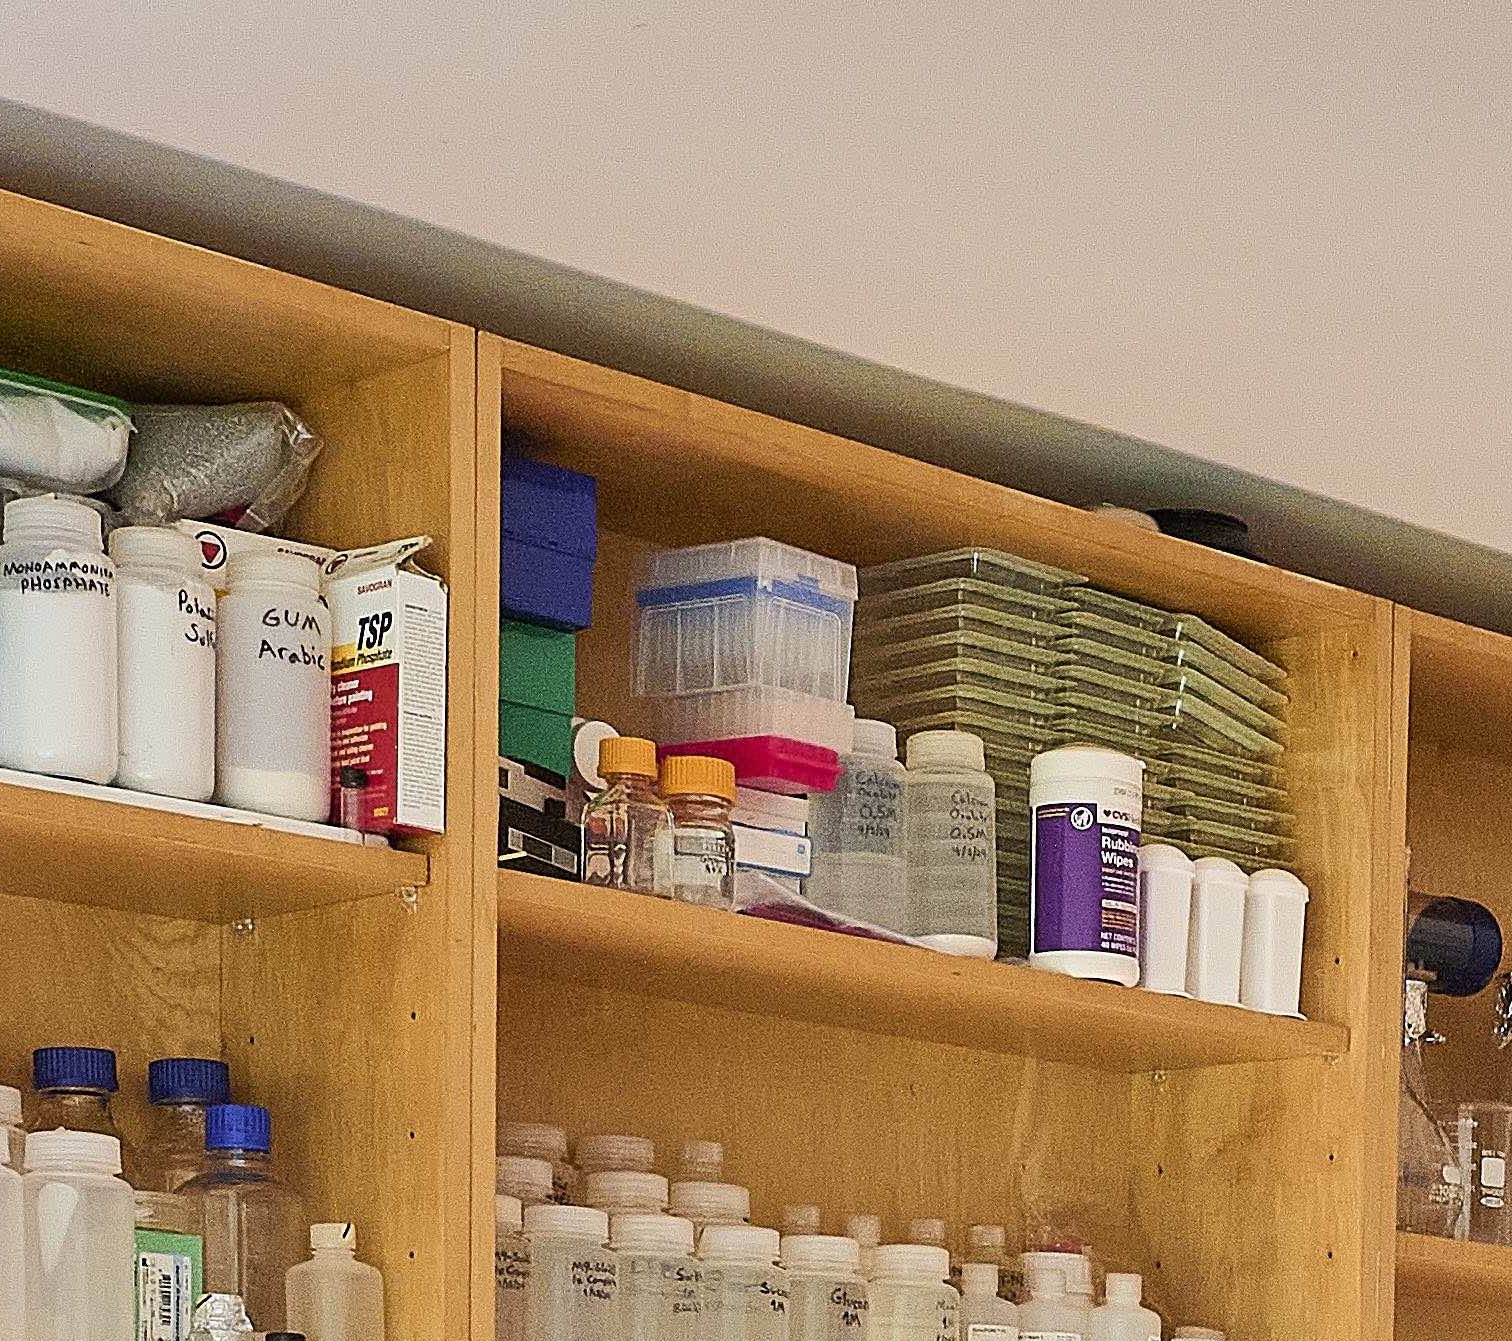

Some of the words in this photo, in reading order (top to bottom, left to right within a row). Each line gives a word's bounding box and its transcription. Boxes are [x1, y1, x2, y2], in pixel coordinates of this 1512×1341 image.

[20, 577, 110, 598] PHOSPHATE
[262, 608, 321, 637] GUM
[357, 611, 393, 651] TSP
[258, 639, 326, 671] Arabic
[1101, 851, 1134, 869] Wipes
